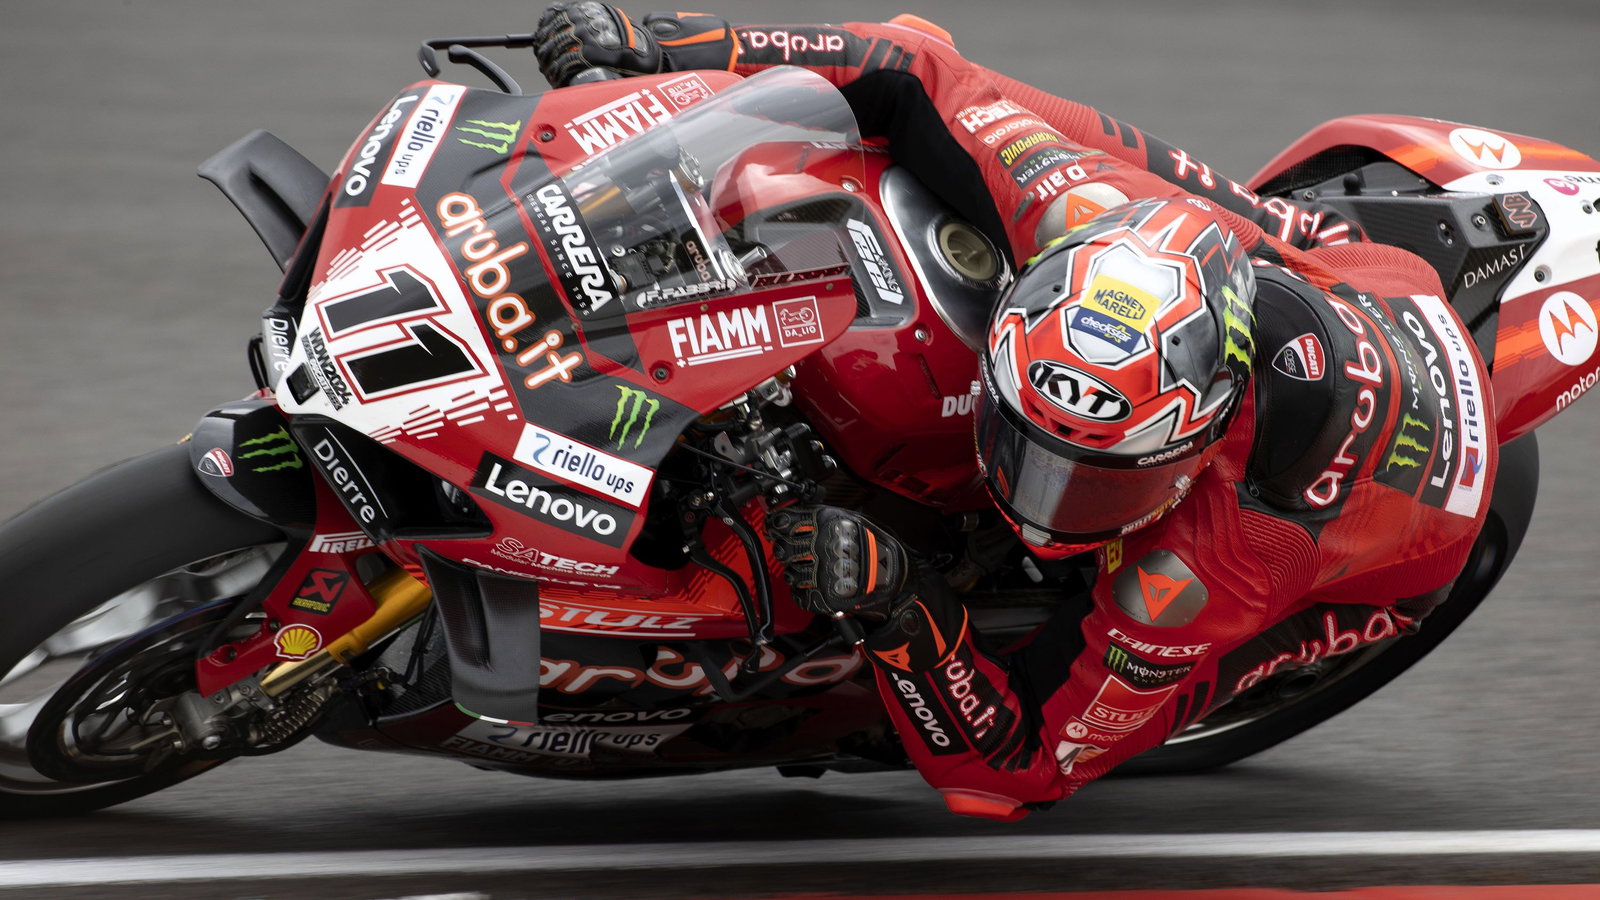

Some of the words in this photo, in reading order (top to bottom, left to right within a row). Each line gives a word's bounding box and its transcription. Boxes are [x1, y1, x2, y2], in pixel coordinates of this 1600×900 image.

[345, 95, 419, 196] Lenovo
[408, 108, 443, 151] riello
[568, 93, 673, 156] FIAMM
[395, 154, 414, 175] ups
[536, 184, 615, 312] CARRERA
[686, 240, 712, 282] aruba
[1464, 244, 1526, 289] DAMAST
[437, 192, 583, 389] aruba.it
[549, 239, 573, 279] SINCE
[572, 286, 590, 316] 1956
[318, 265, 490, 404] 11
[667, 304, 772, 358] FIAMM
[1438, 314, 1463, 352] ups
[309, 327, 353, 405] WDW2024
[1305, 339, 1319, 375] DUCATI
[941, 394, 975, 418] DU
[1033, 362, 1124, 415] KYT
[1402, 311, 1453, 488] Lenovo
[1457, 362, 1480, 443] riello
[215, 451, 231, 474] DUCATI
[552, 445, 605, 481] riello
[606, 473, 634, 493] ups
[1137, 441, 1193, 465] CARRERA
[484, 462, 617, 536] Lenovo
[309, 531, 379, 553] PIRELL
[495, 537, 620, 574] SATECH
[539, 602, 703, 629] STULZ
[1107, 628, 1212, 657] DAINESE
[1126, 661, 1192, 679] MONSTER
[543, 708, 692, 722] enovo
[945, 655, 997, 739] uba.it
[612, 733, 662, 747] ups
